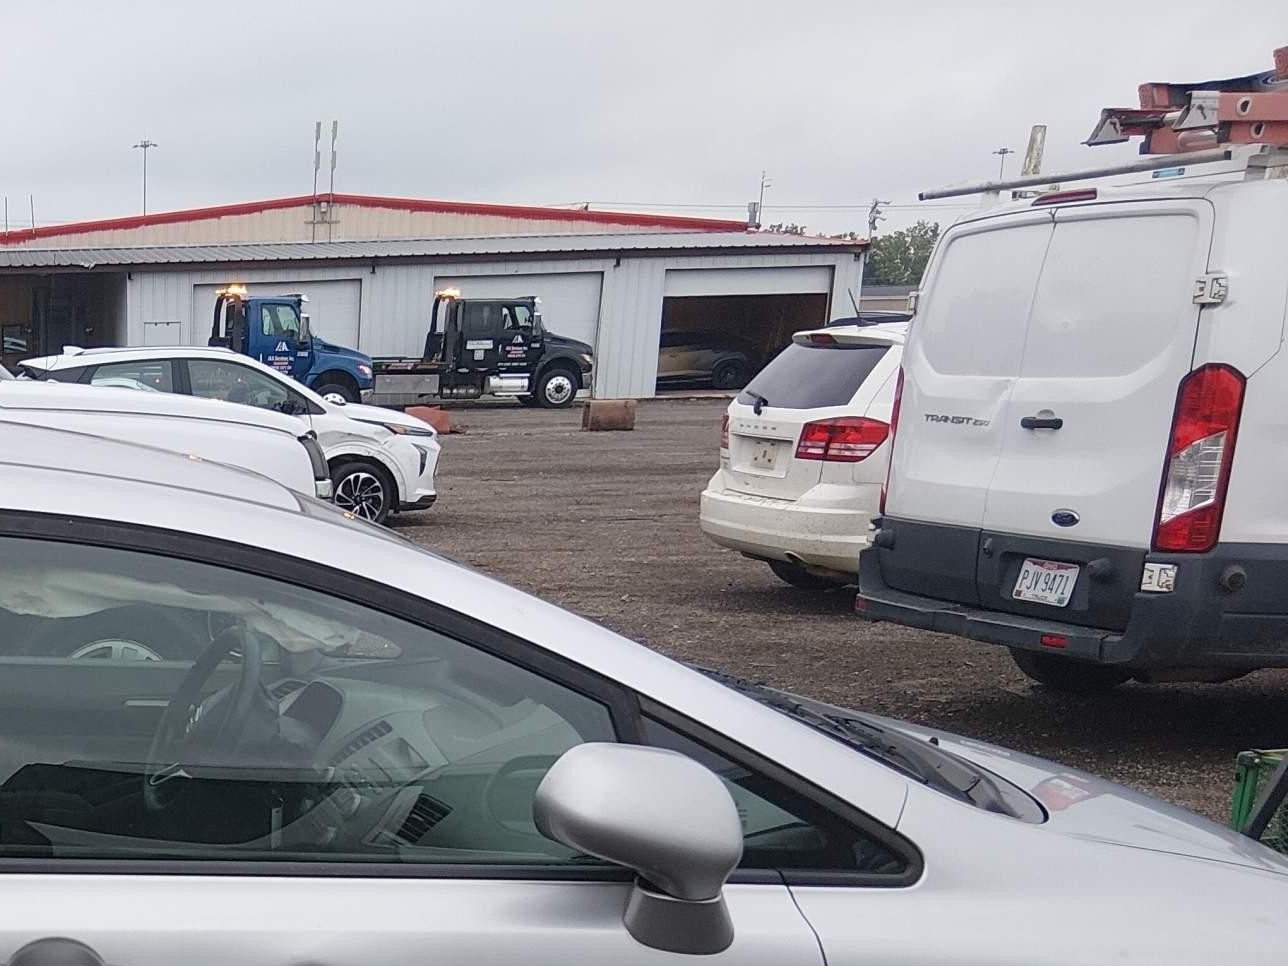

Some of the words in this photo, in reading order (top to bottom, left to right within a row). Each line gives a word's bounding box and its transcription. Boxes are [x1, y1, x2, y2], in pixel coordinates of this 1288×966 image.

[924, 414, 973, 425] TRANSIT
[1019, 569, 1043, 591] PJV
[1041, 572, 1070, 595] 9471
